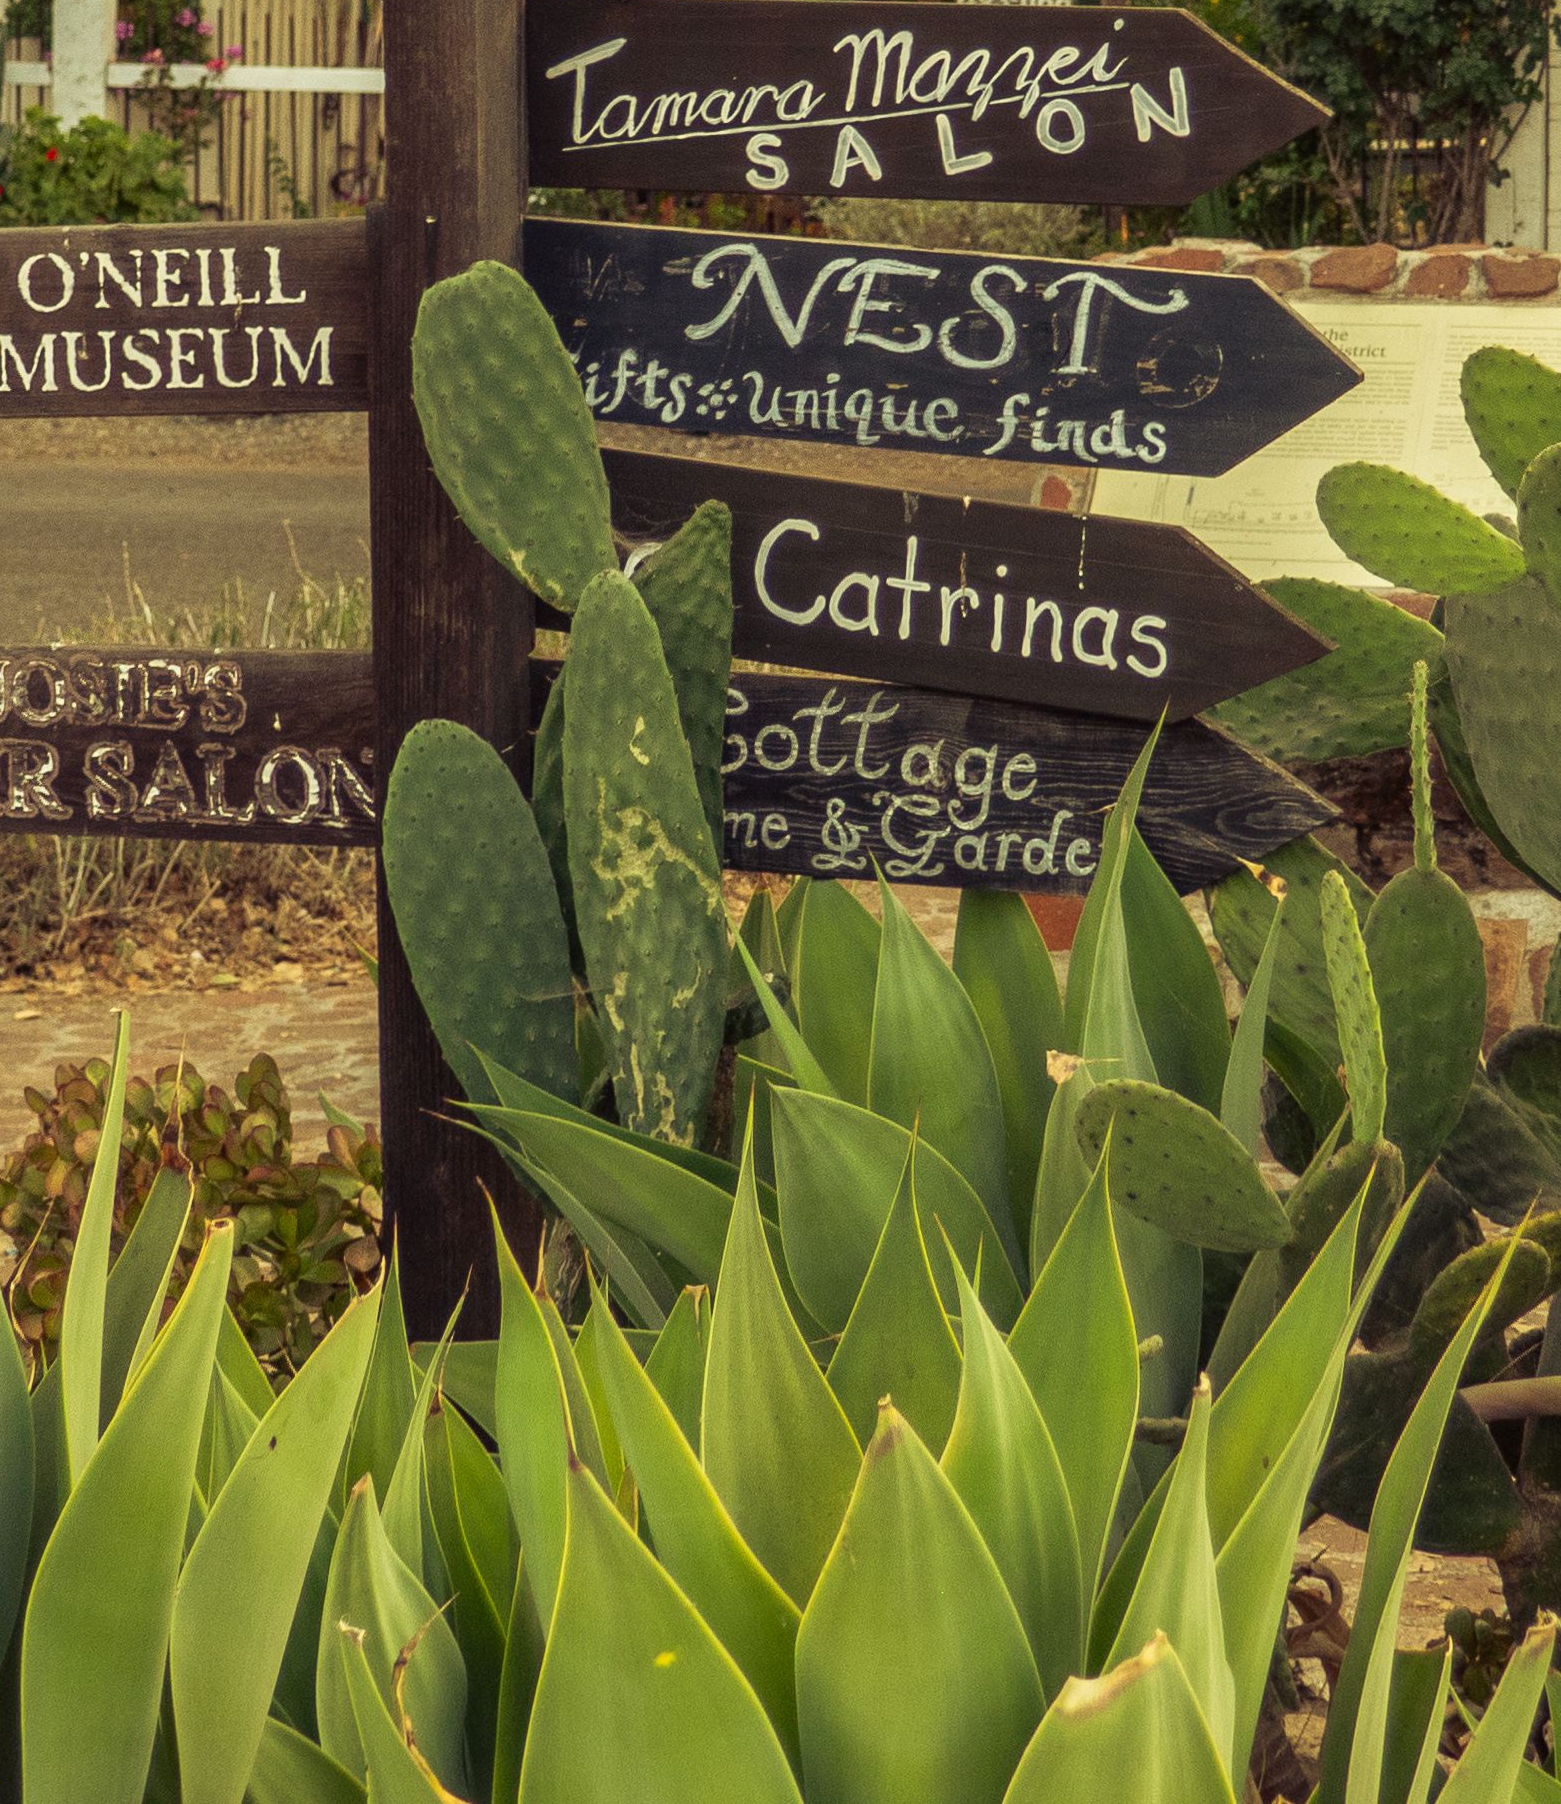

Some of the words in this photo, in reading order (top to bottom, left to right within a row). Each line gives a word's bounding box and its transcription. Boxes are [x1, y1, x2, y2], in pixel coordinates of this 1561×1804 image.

[547, 37, 825, 145] Tamara
[833, 18, 1129, 122] Mazzei
[744, 67, 1191, 190] SALON
[17, 246, 307, 314] O'NEILL
[684, 243, 1190, 376] NEST
[580, 348, 693, 424] ifts
[983, 392, 1168, 464] finds
[1340, 344, 1387, 358] istrict
[754, 518, 1171, 679] Catrinas
[83, 739, 377, 826] SALON
[810, 797, 870, 871] &
[872, 790, 1102, 877] Garde
